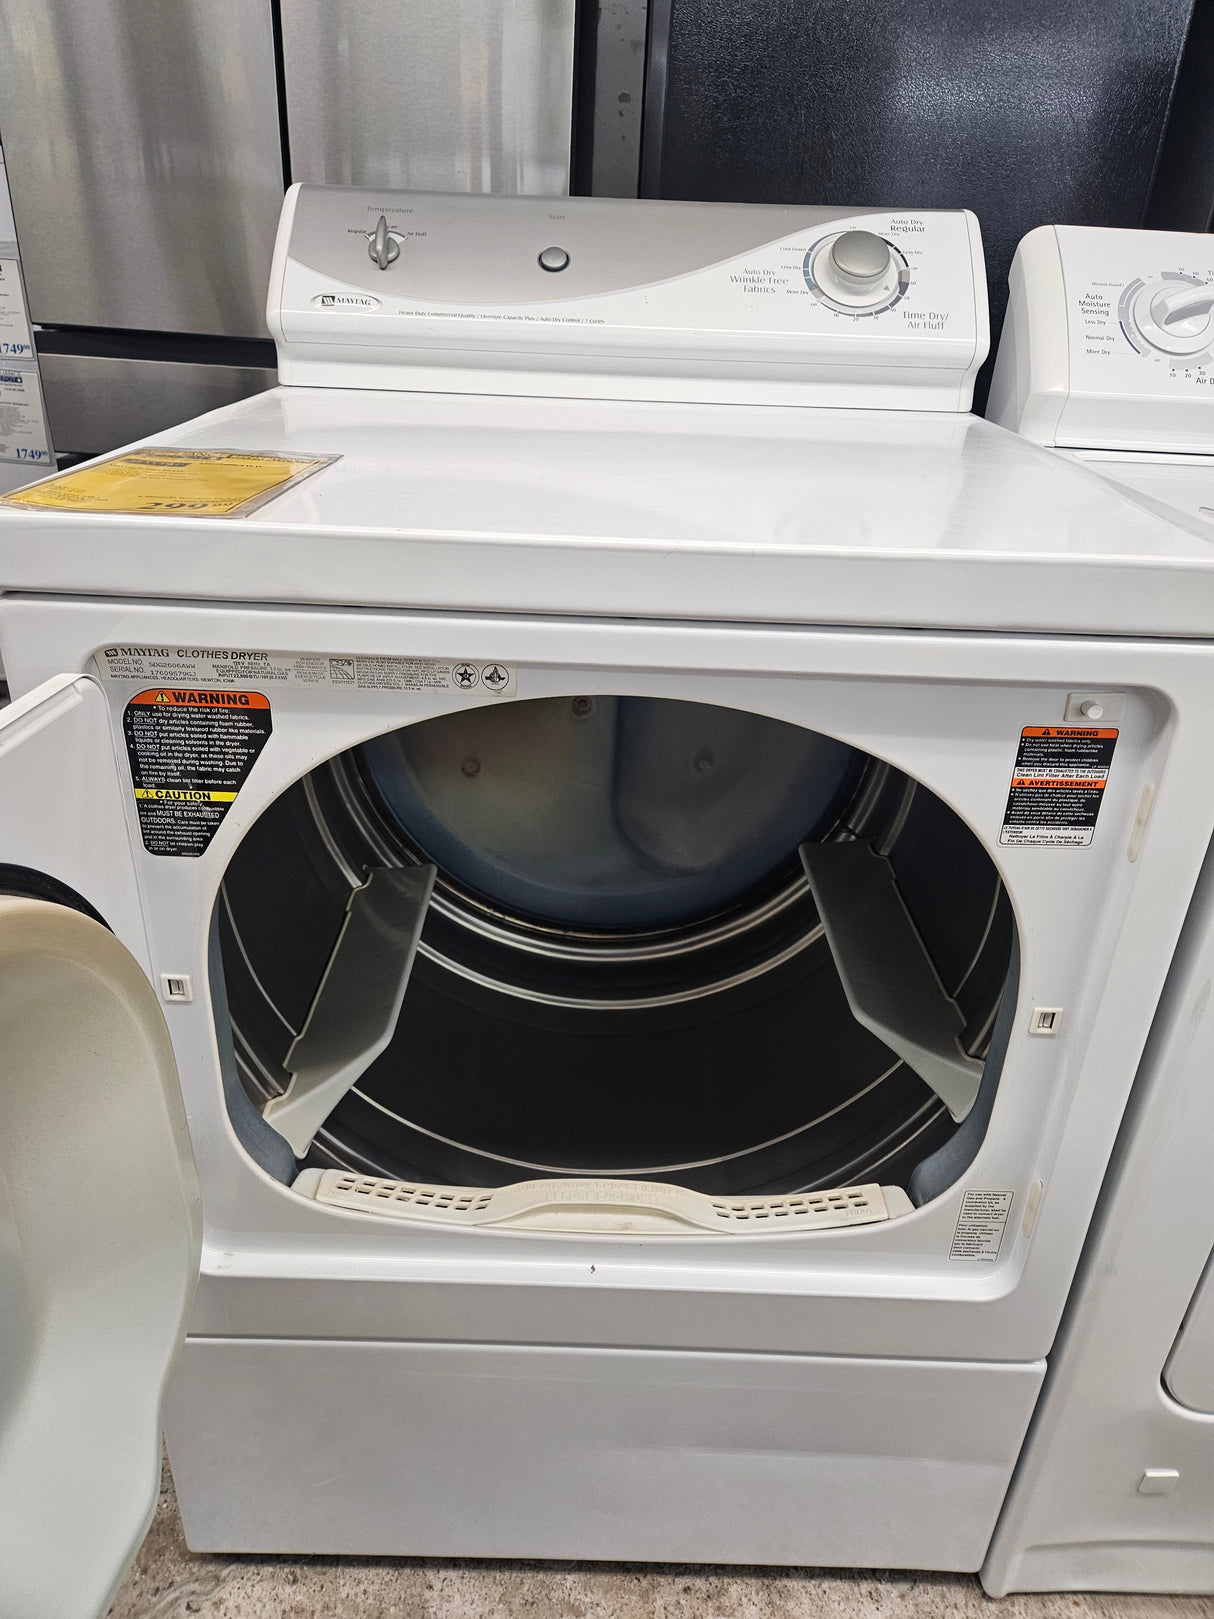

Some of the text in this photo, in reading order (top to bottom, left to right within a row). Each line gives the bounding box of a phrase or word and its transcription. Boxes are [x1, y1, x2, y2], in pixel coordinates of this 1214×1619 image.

[366, 206, 414, 214] Temperature
[730, 275, 766, 283] Wrinkle
[336, 297, 371, 306] MAYTAG
[1078, 300, 1111, 308] Moisture
[902, 311, 949, 321] Time Dry/
[1082, 308, 1109, 316] Sensing
[907, 321, 944, 330] Air Fluff
[120, 648, 268, 661] MAYTAG CLOTHES DRYER
[172, 692, 249, 705] WARNING
[155, 791, 211, 800] CAUTION
